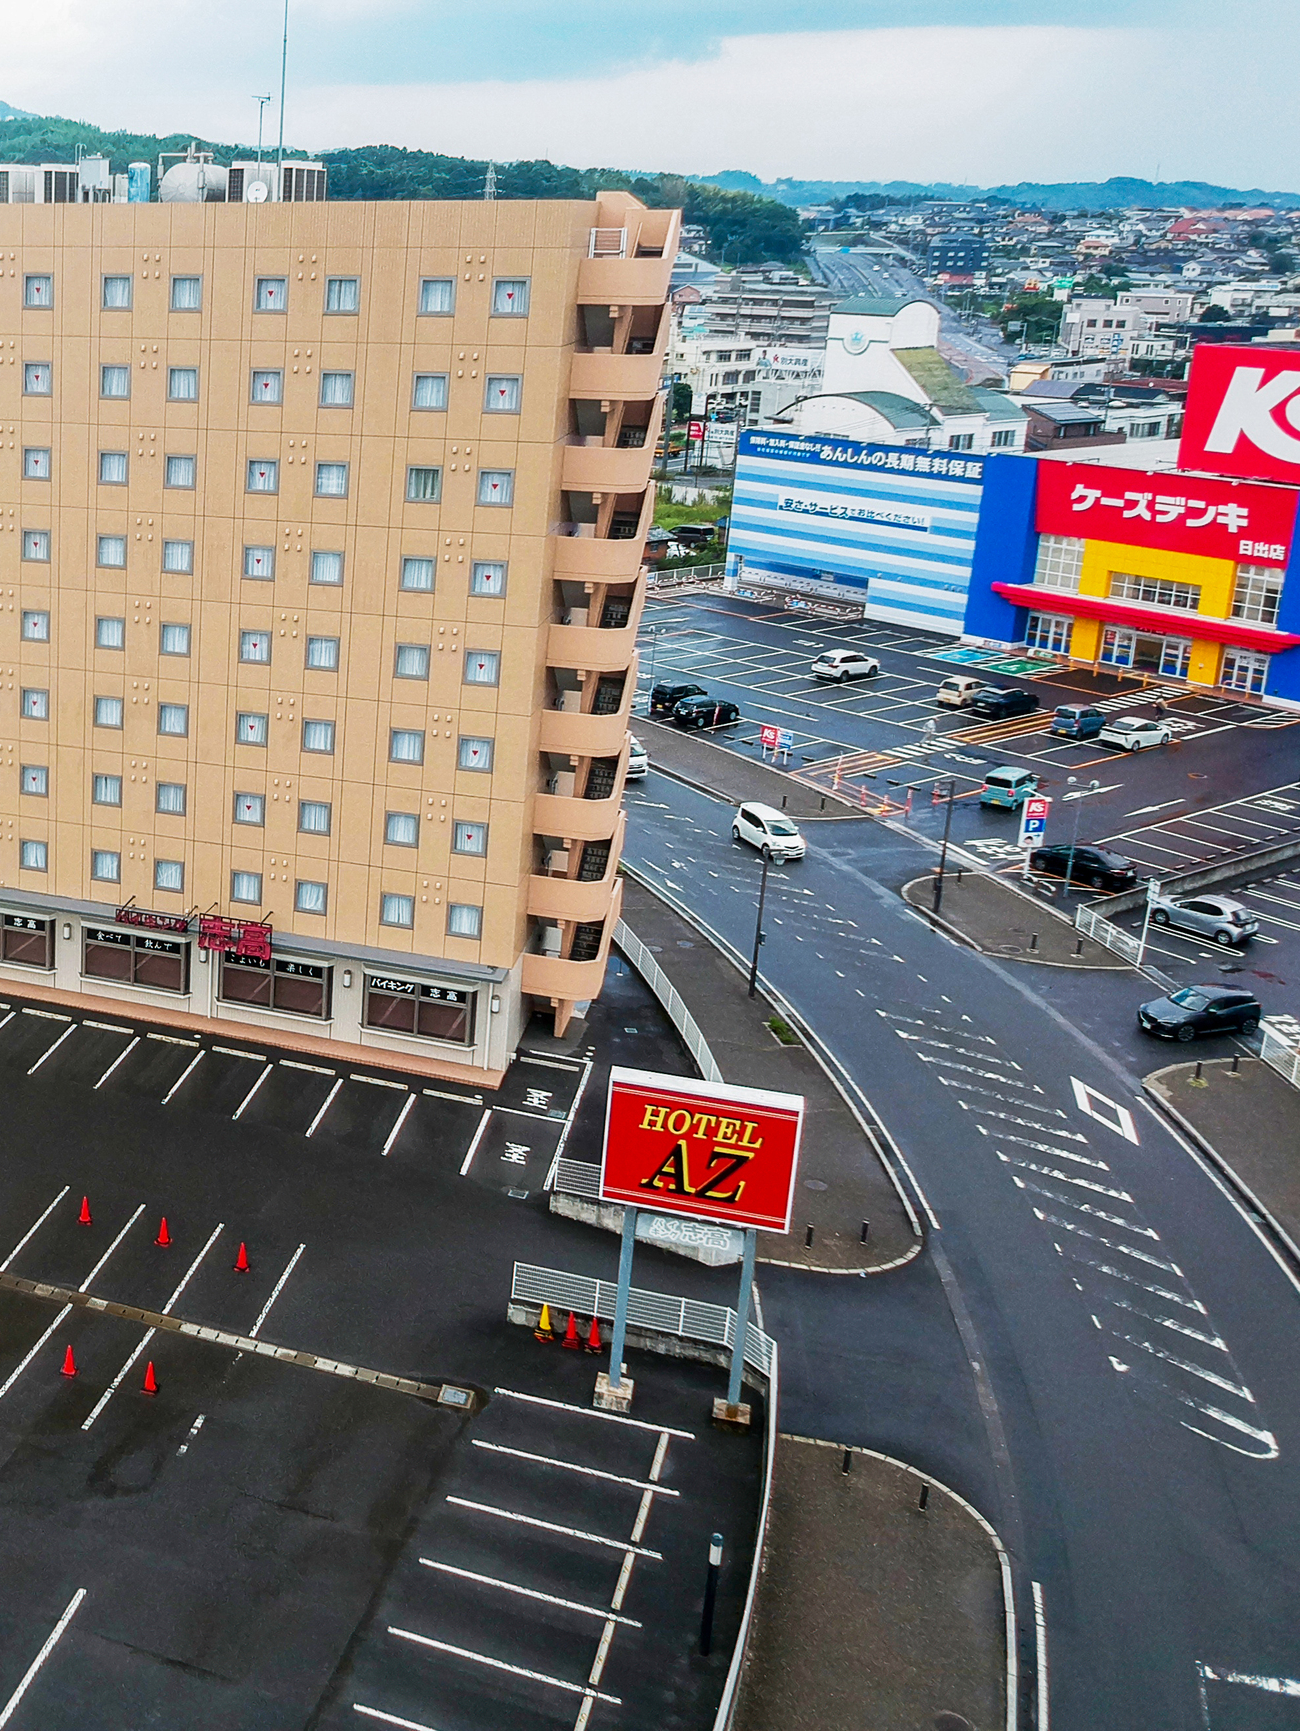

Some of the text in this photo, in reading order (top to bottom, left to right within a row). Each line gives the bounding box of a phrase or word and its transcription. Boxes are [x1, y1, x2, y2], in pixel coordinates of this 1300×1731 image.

[819, 444, 983, 480] あんしんの長期無料保証
[1070, 484, 1249, 533] ケーズデンキ
[1238, 540, 1286, 561] 日出店
[1028, 820, 1040, 831] P
[13, 917, 37, 929] 志高
[97, 931, 173, 951] 食べて 飲んで
[286, 962, 314, 976] 楽しく
[371, 977, 458, 1001] バイキング 志高
[639, 1104, 763, 1149] HOTEL
[639, 1139, 755, 1203] AZ
[680, 1222, 732, 1250] 志高
